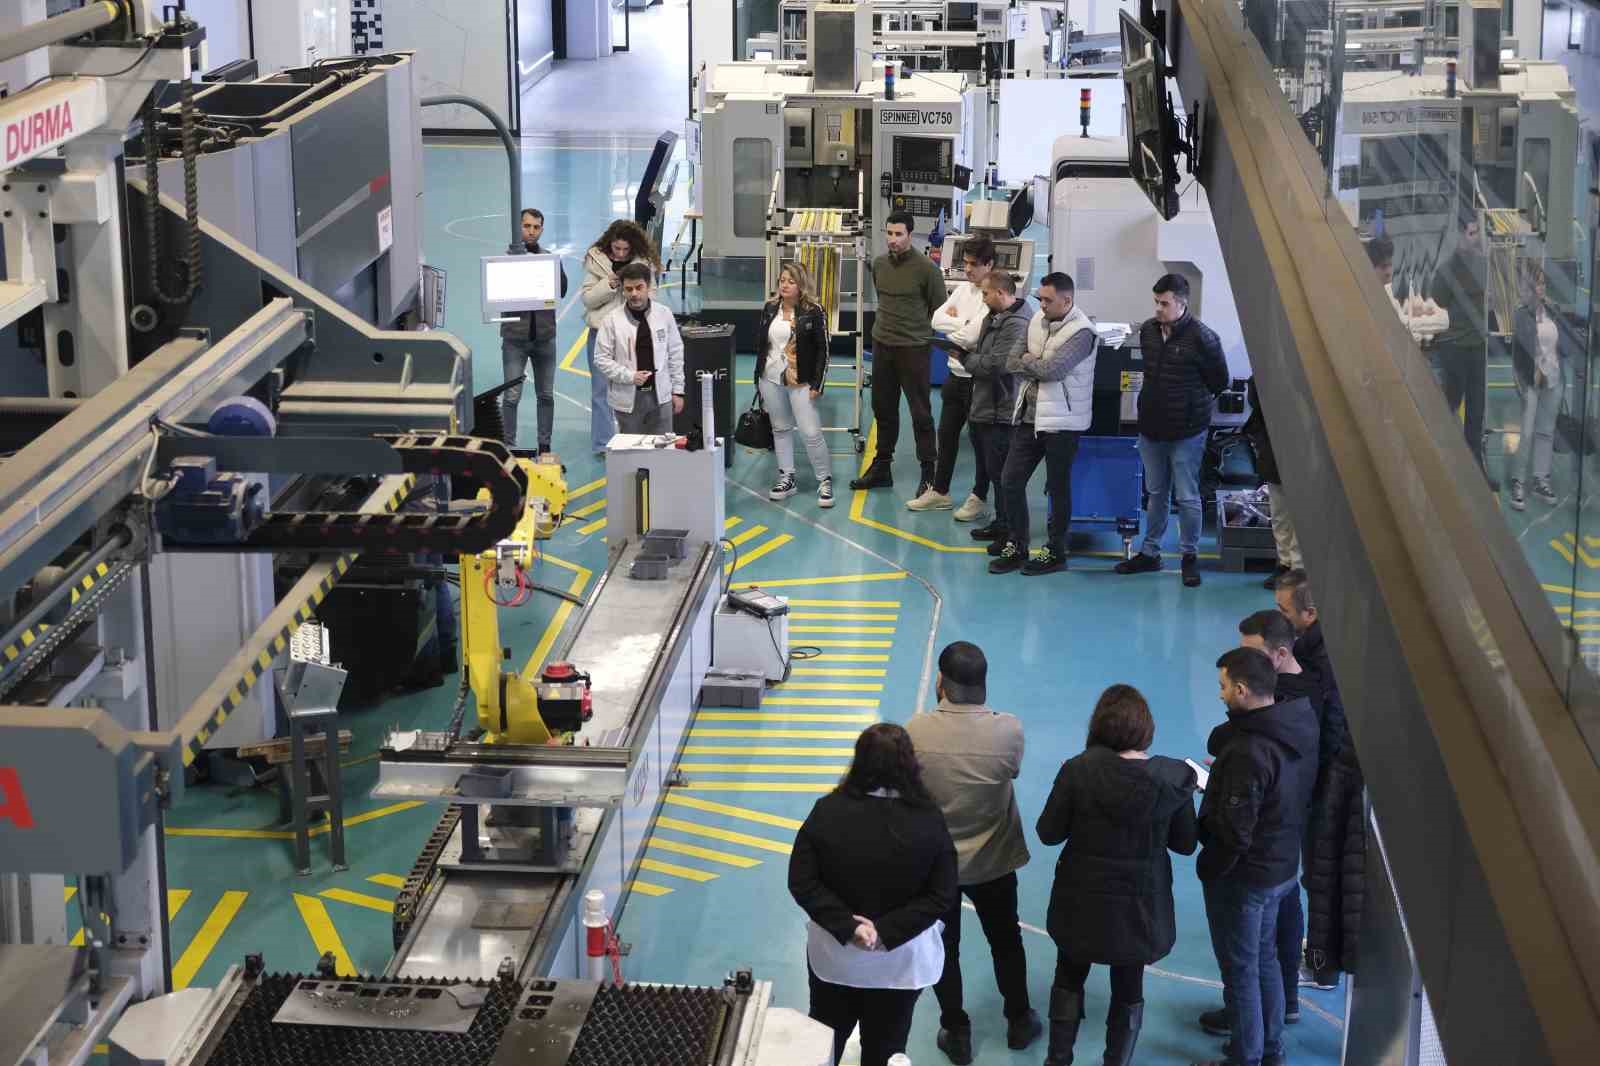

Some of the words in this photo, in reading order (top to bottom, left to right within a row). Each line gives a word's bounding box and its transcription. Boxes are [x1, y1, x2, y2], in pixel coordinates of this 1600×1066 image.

[7, 101, 73, 161] DURMA
[882, 111, 917, 121] SPINNER
[920, 111, 953, 124] VC750
